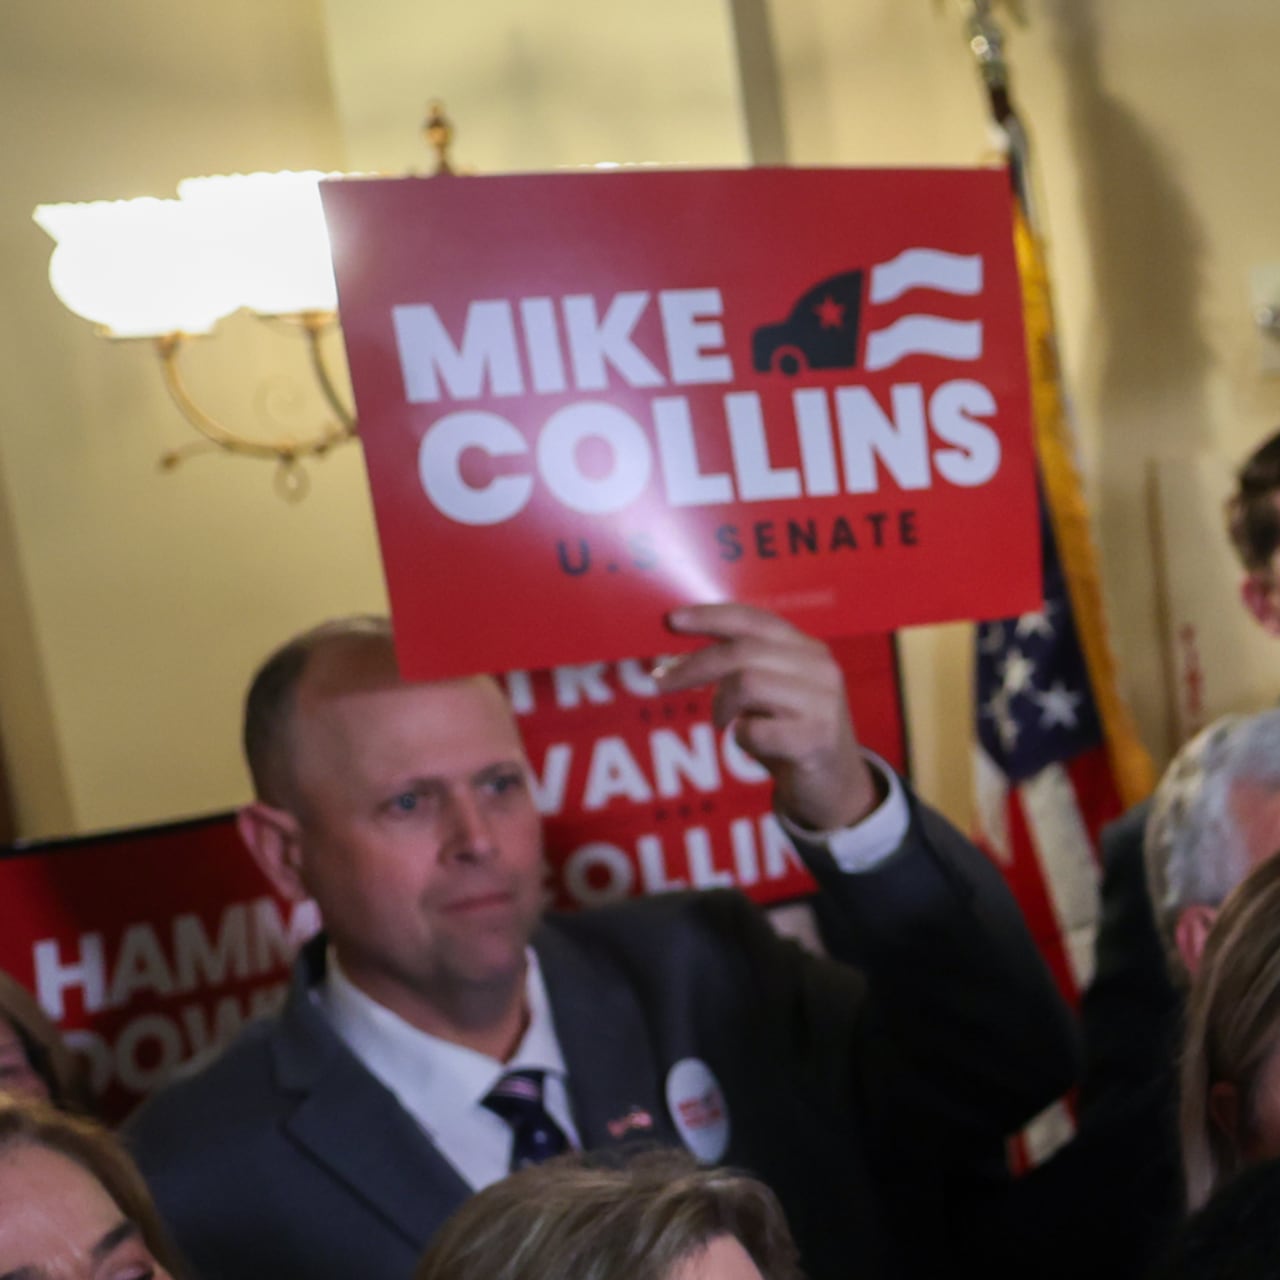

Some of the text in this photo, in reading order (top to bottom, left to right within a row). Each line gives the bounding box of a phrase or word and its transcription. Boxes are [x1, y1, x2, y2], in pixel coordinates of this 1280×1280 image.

[392, 288, 733, 403] MIKE
[418, 380, 1001, 526] COLLINS
[557, 510, 920, 577] U.S SENATE
[528, 723, 773, 816] VANC
[560, 811, 806, 900] OLLI
[33, 896, 323, 1021] HAMM
